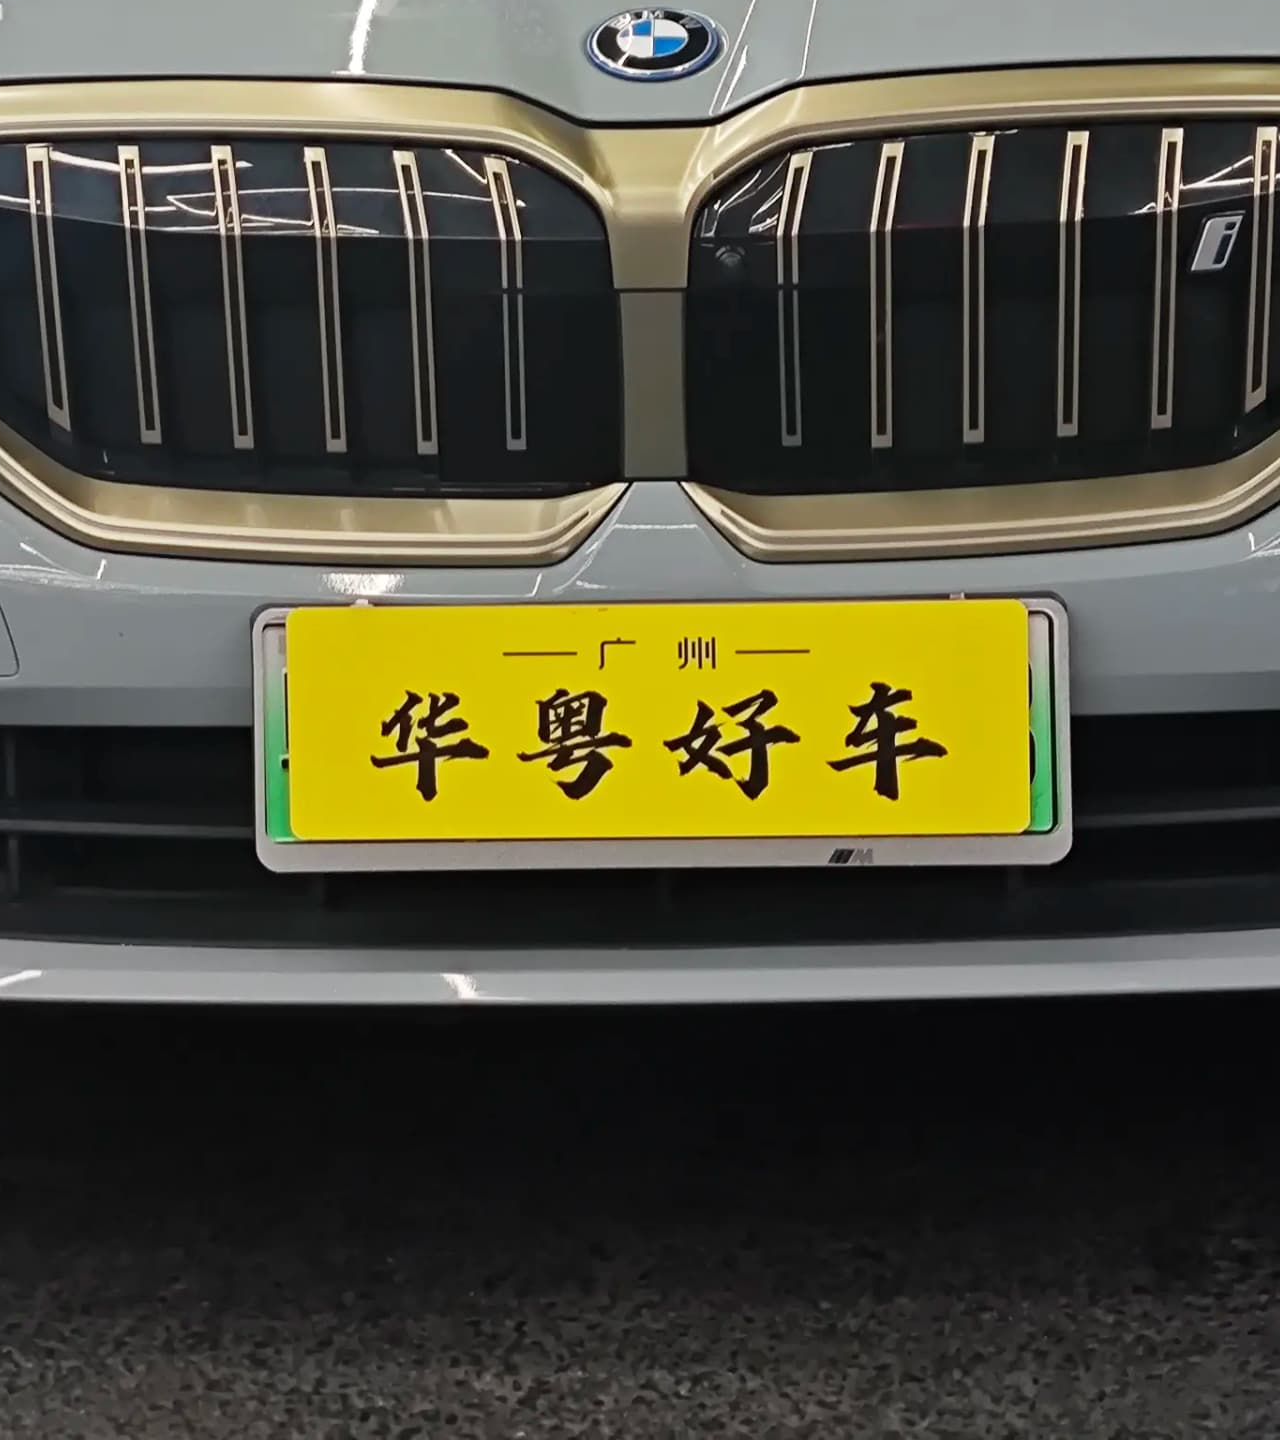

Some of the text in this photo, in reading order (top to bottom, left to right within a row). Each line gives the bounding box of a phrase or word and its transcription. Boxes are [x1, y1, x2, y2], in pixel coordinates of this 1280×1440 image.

[609, 10, 701, 29] BMW
[598, 637, 716, 670] 广州
[369, 682, 948, 802] 华粤好车
